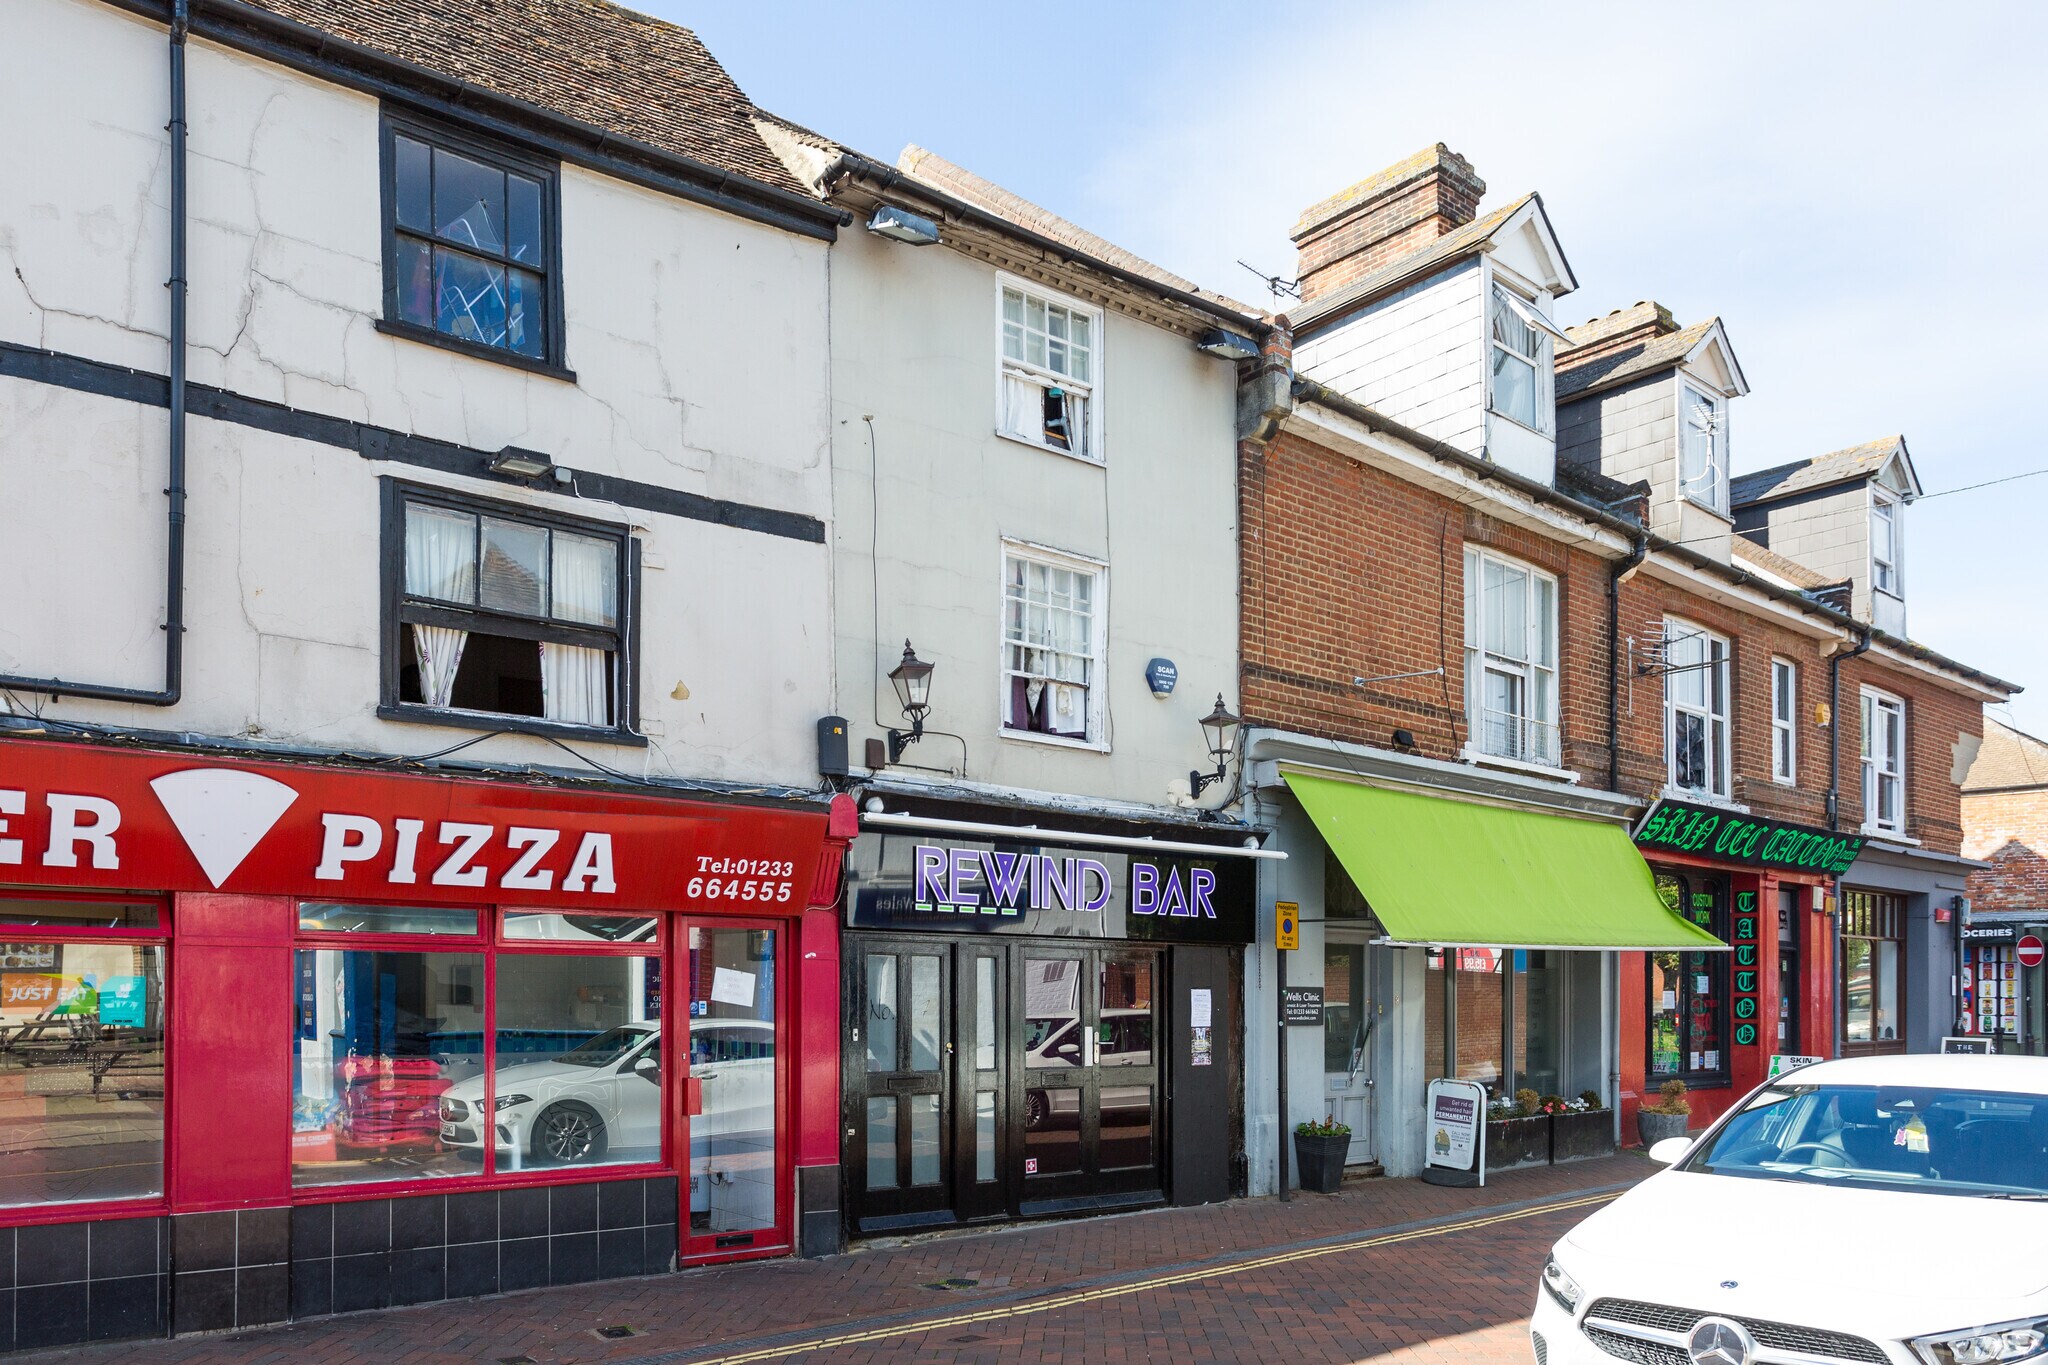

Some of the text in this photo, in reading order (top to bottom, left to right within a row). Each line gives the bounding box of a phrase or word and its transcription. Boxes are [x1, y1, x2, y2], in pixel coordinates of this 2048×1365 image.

[1158, 666, 1174, 675] SCAN
[1638, 806, 1847, 868] SKIN TEC TATTOO
[315, 812, 617, 894] PIZZA
[686, 877, 792, 902] 664555
[915, 845, 1217, 919] REWIND BAR
[1692, 893, 1713, 907] CUSTOM
[1695, 910, 1710, 923] WORK
[1961, 928, 2013, 938] OCERIES
[1736, 891, 1755, 1045] TATTOO
[8, 987, 92, 1002] JUST EAT
[1286, 992, 1320, 1001] Wells Clinic
[870, 998, 895, 1020] No.
[1436, 1111, 1472, 1121] PERMANENTLY
